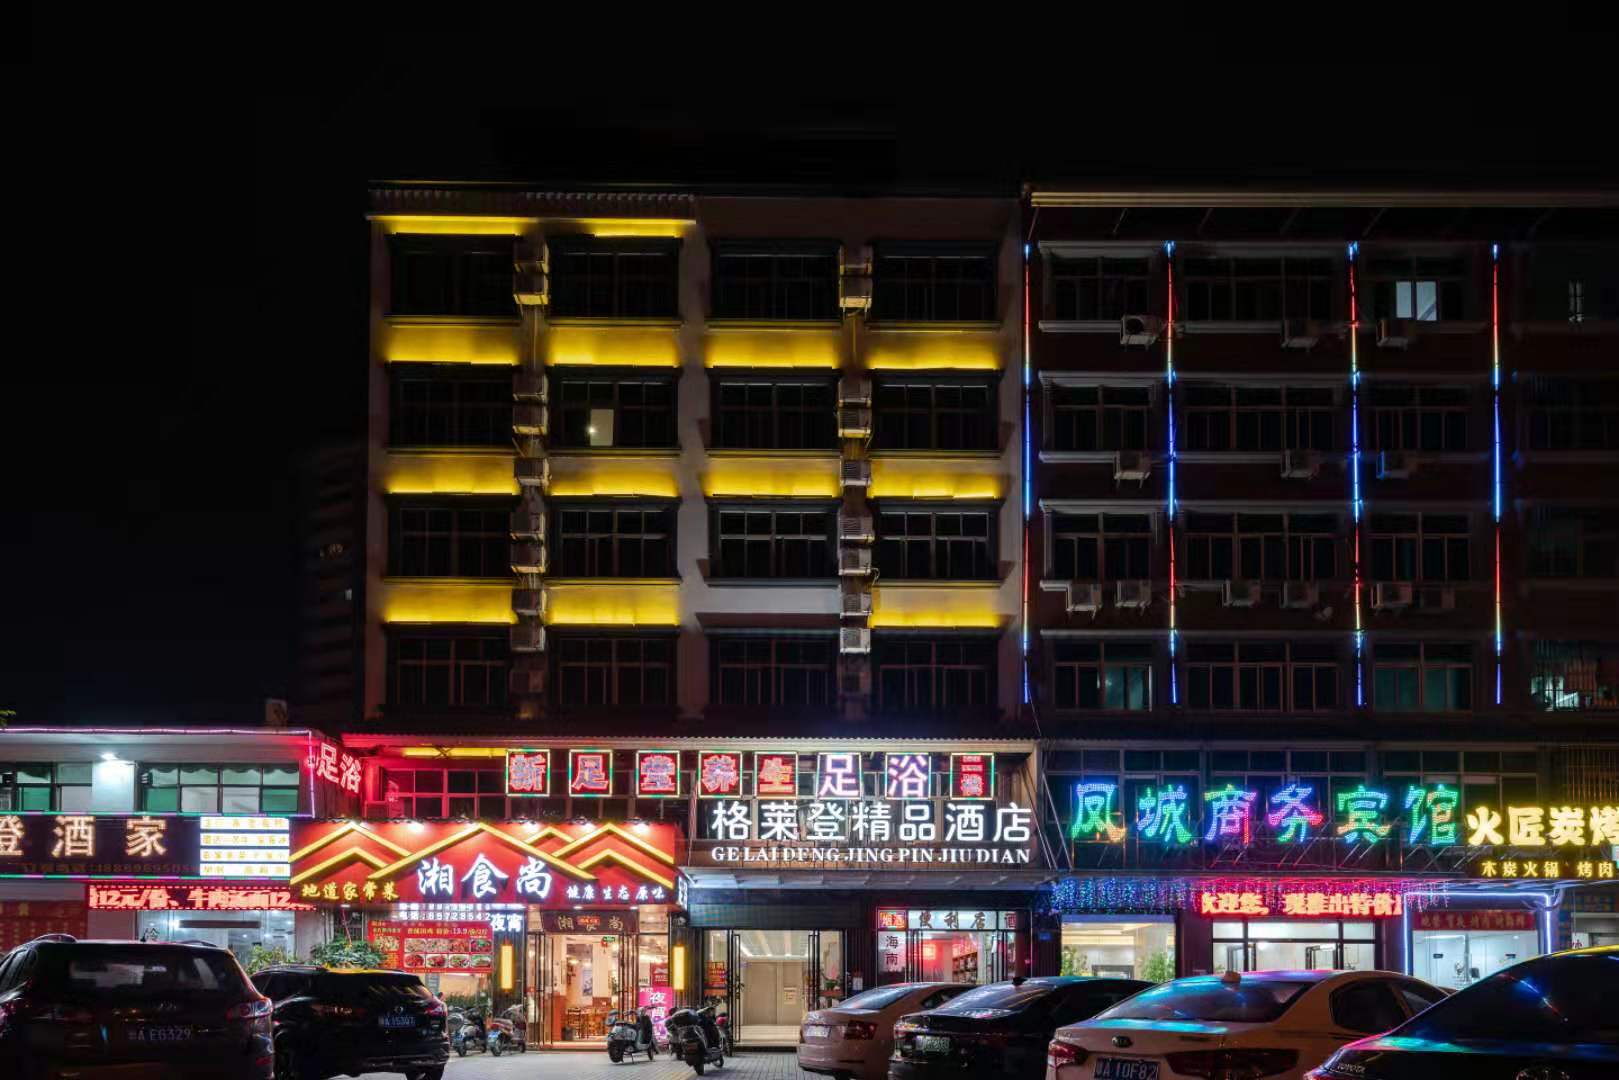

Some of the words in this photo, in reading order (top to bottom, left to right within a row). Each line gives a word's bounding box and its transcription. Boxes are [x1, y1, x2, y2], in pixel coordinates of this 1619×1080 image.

[317, 742, 362, 794] 足浴
[711, 801, 1032, 842] 格莱登精品酒店
[1071, 785, 1460, 846] 凤城商务宾馆
[416, 852, 553, 899] 湘食尚
[1577, 861, 1613, 878] 烤肉
[302, 882, 399, 901] 地道家常菜
[919, 911, 987, 930] 便利店
